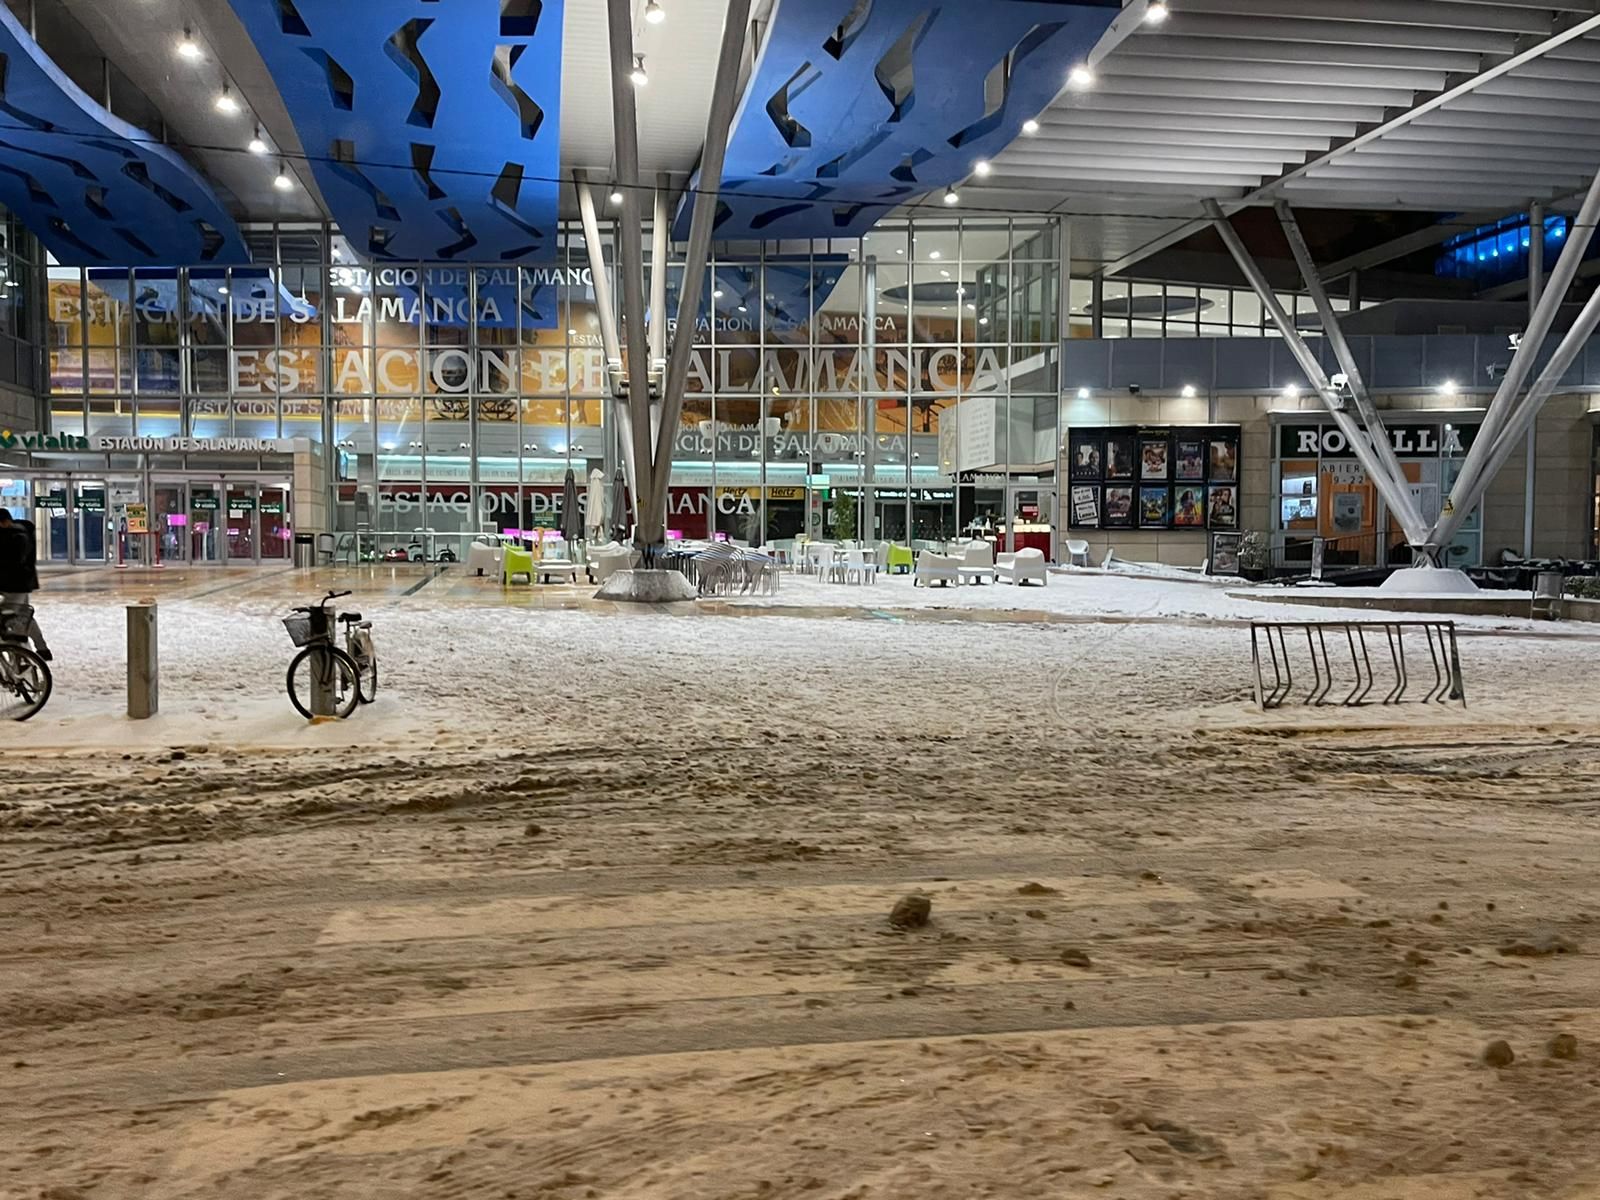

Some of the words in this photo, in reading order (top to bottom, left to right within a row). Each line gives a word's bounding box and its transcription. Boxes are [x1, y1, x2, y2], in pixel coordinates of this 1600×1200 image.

[477, 267, 594, 287] SALAMANC
[235, 299, 276, 324] DE
[683, 348, 1008, 394] ALAMANCA
[171, 440, 188, 450] DE
[192, 439, 277, 451] SALAMANCA
[1297, 429, 1463, 452] ROLLA
[380, 492, 519, 514] ESTACON
[771, 487, 796, 497] Hertz
